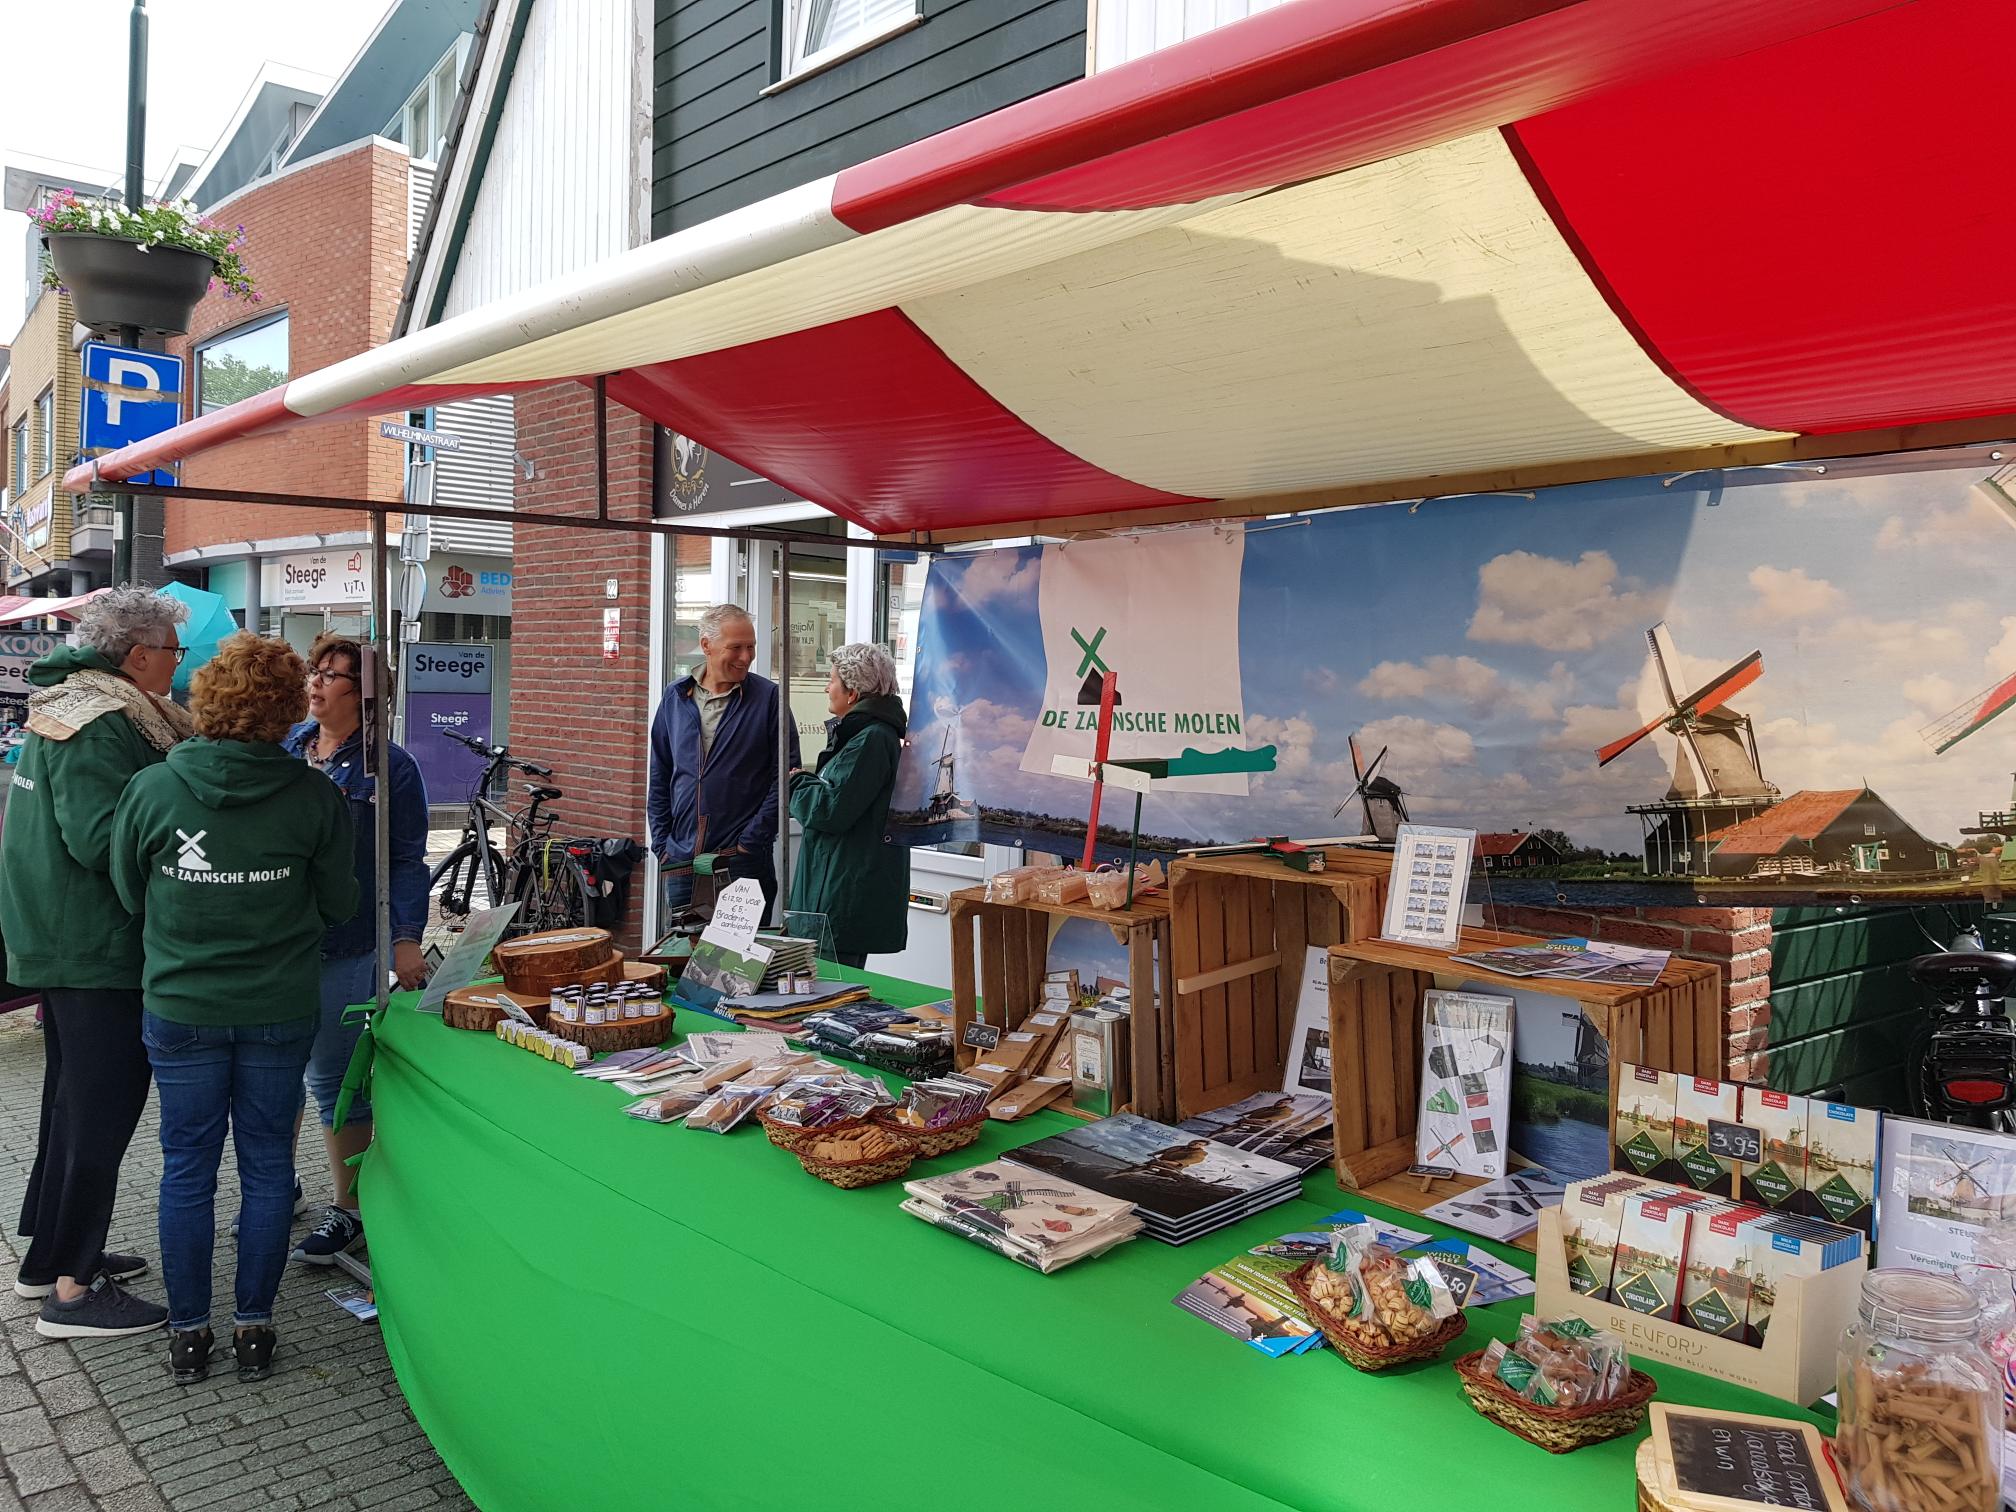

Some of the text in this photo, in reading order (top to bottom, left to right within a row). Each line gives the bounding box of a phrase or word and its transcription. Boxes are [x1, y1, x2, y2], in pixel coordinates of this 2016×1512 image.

[107, 357, 160, 425] P
[383, 424, 459, 449] WILHELMINASTRAAT
[285, 563, 327, 589] Steege
[458, 650, 485, 659] Van de
[415, 653, 485, 679] Steege
[431, 713, 468, 726] Steege
[1041, 710, 1241, 735] DE ZANSCHE MOLEN
[161, 865, 290, 884] DE ZAANSCHE MOLEN
[734, 885, 750, 894] VAN
[1687, 1162, 1716, 1175] CHOCOLADE
[1756, 1178, 1787, 1191] CHOCOLADE
[1822, 1193, 1855, 1206] CHOCOLADE
[1426, 1251, 1461, 1259] WIND
[1950, 1250, 1976, 1263] Word
[1910, 1253, 1959, 1272] Vereniging
[1219, 1269, 1237, 1281] SAMEN
[1625, 1292, 1657, 1307] CHOCOLADE
[1610, 1316, 1626, 1330] DE
[1695, 1308, 1728, 1324] CHOCOLADE
